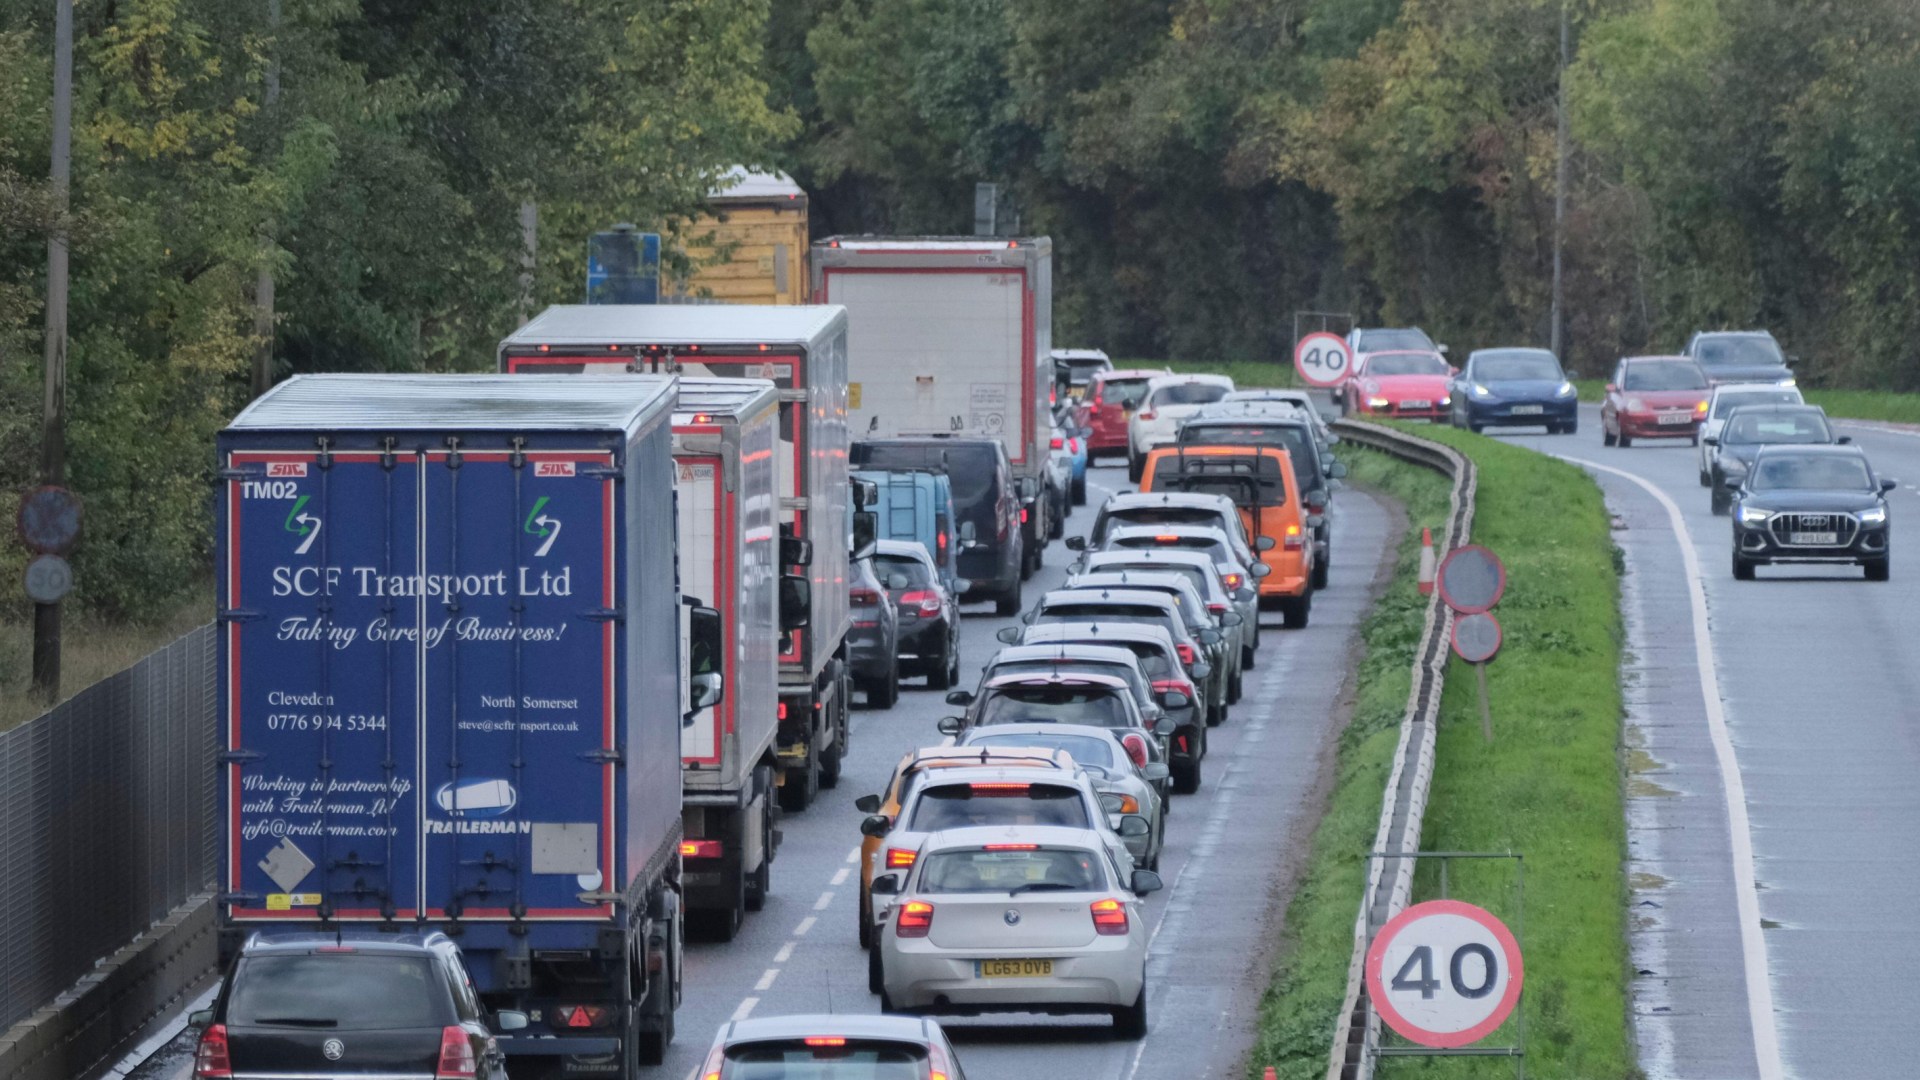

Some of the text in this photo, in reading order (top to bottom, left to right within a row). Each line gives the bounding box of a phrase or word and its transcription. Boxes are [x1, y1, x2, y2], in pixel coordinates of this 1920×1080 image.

[1303, 346, 1344, 371] 40
[694, 468, 713, 478] ADAMS
[240, 481, 298, 499] TM02
[273, 566, 572, 604] SCF Transport Ltd
[276, 616, 567, 650] Taking Care of Business!
[268, 692, 334, 706] Clevedon
[482, 696, 578, 709] North Somerset
[268, 715, 308, 730] 0776
[347, 715, 386, 731] 5344
[458, 720, 579, 732] steve@scftrnsport.co.uk
[242, 775, 411, 798] Working in partnership
[242, 797, 274, 813] with
[280, 798, 364, 814] Trailerman
[242, 819, 398, 840] info@trailerman.com
[424, 819, 531, 834] TRAILERMAN
[983, 961, 1052, 976] LG63 OVB
[1391, 942, 1499, 1000] 40
